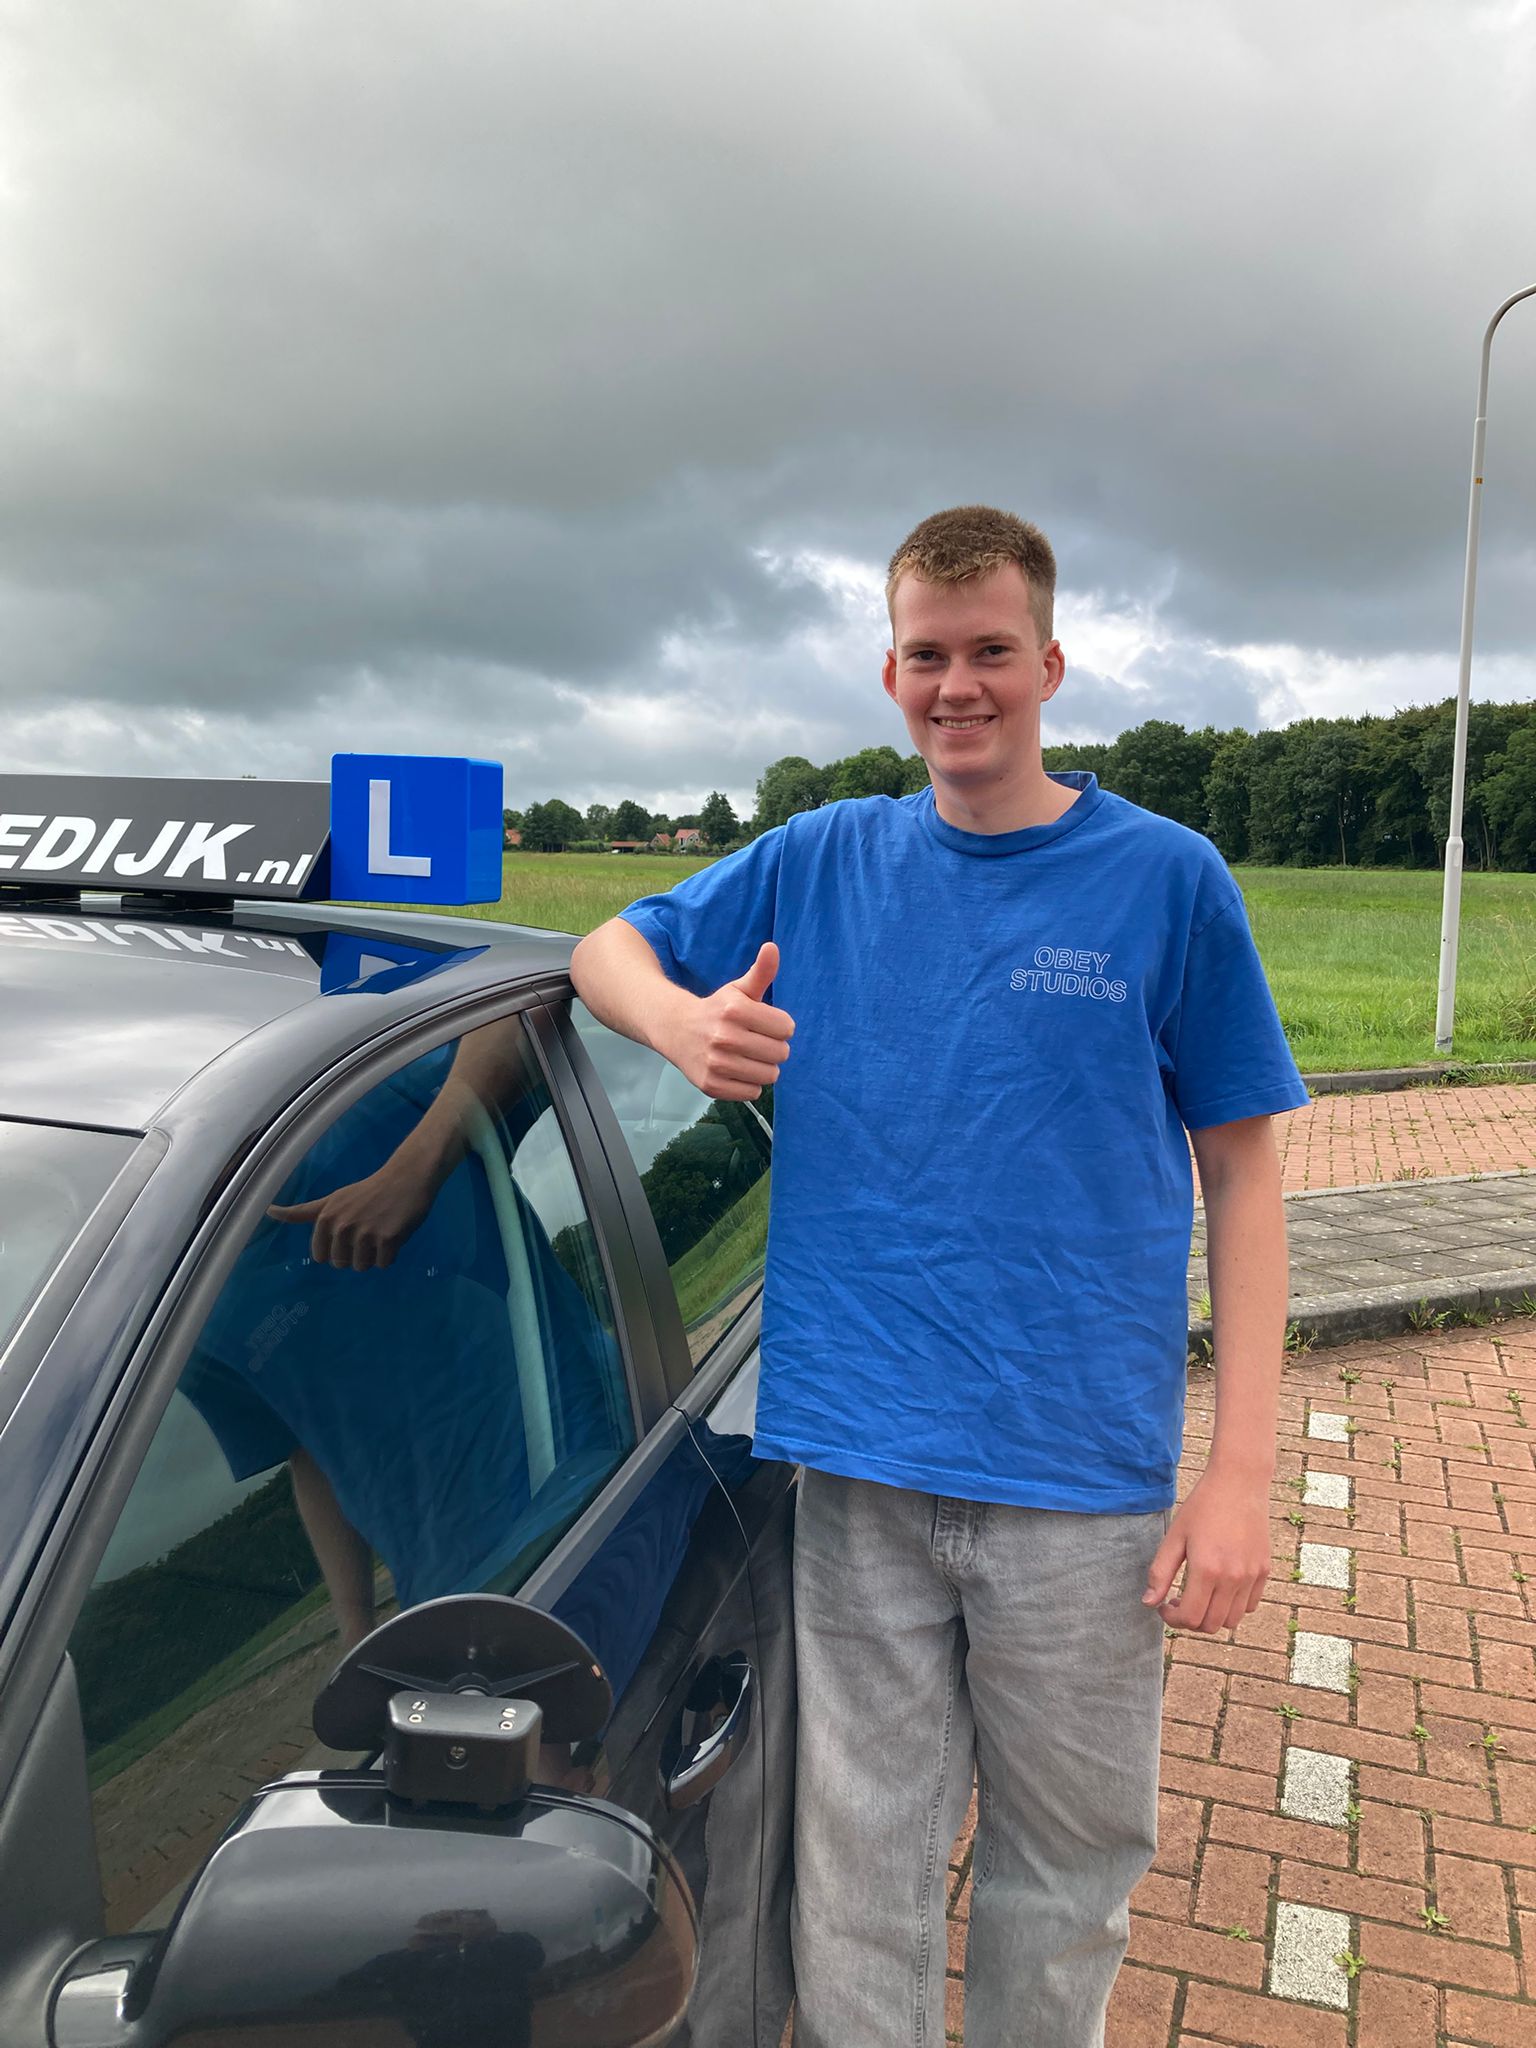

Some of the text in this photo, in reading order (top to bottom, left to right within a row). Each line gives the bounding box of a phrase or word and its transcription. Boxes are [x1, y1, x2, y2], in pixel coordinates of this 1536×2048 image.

[369, 779, 431, 877] L
[1034, 946, 1111, 974] OBEY
[1010, 969, 1127, 1003] STUDIOS
